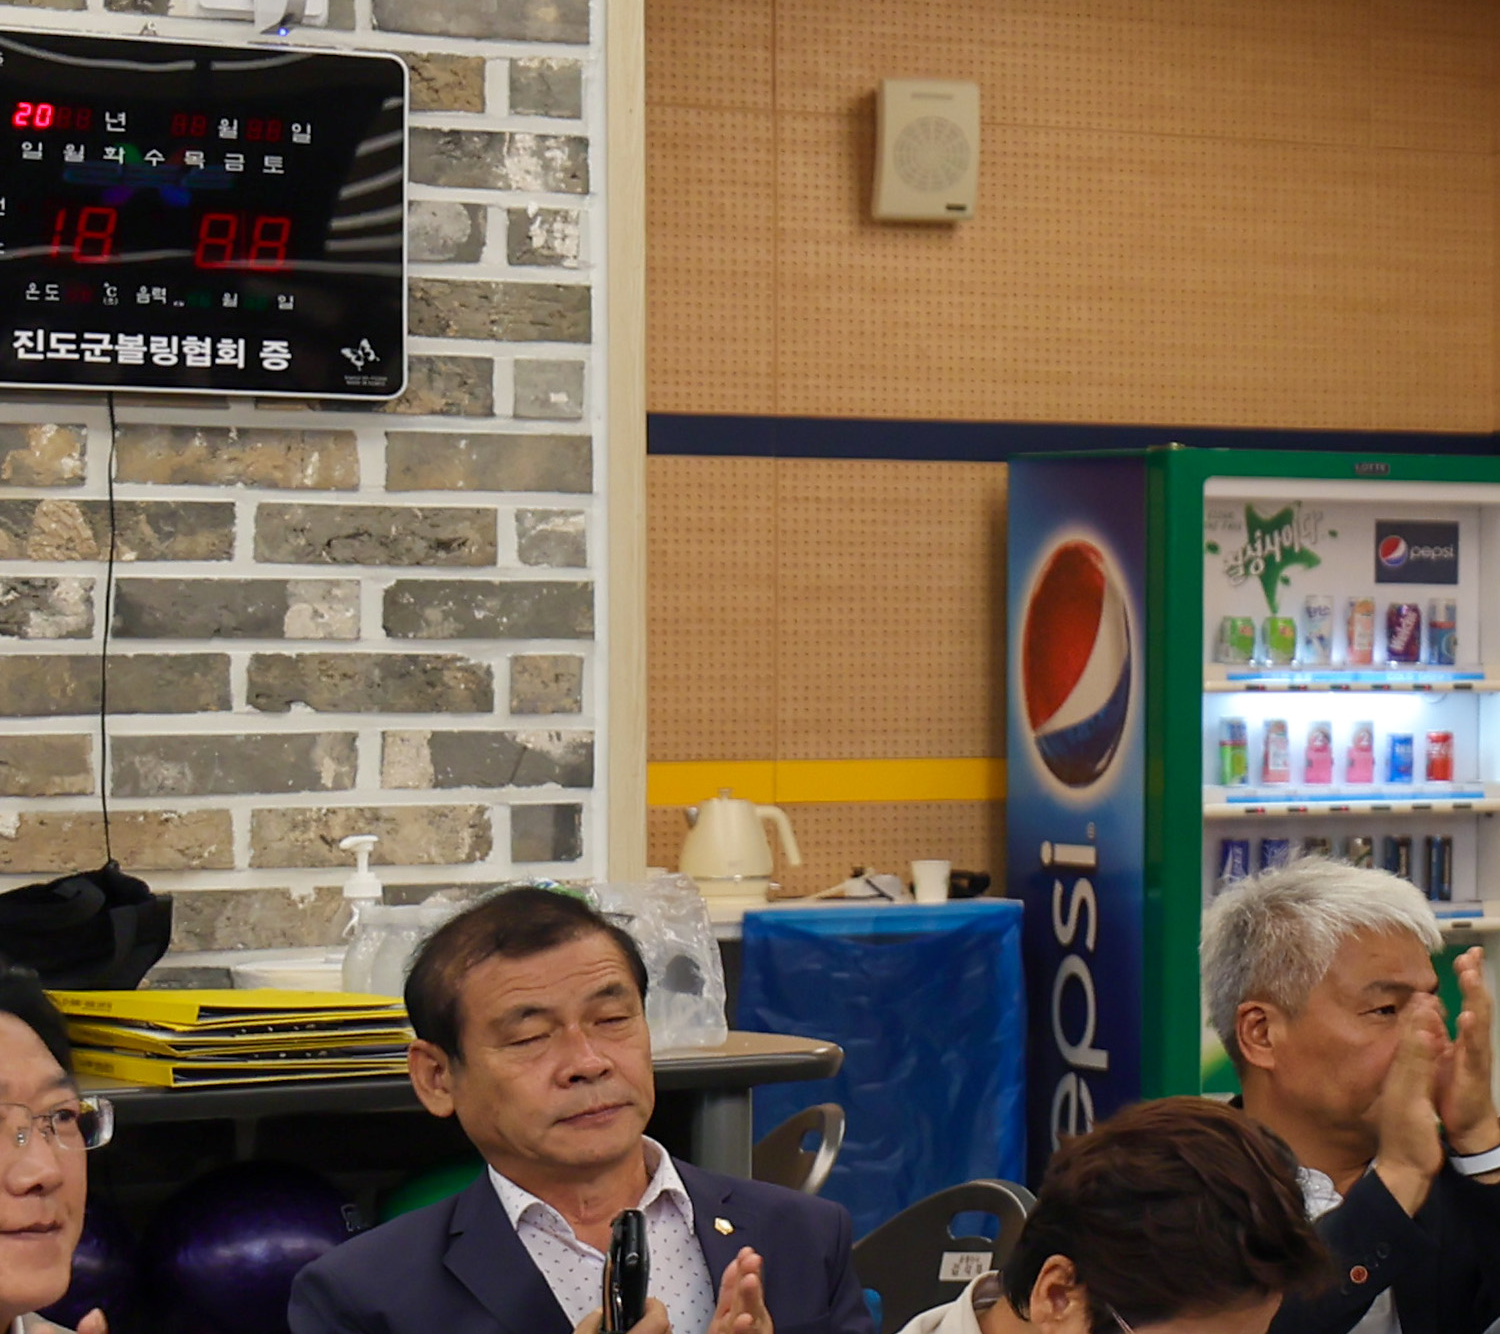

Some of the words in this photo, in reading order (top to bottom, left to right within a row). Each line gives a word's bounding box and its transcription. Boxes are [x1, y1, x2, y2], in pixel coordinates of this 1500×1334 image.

[105, 112, 126, 132] 년
[217, 118, 238, 140] 월
[291, 123, 312, 144] 일
[22, 141, 43, 161] 일
[63, 144, 84, 163] 월
[103, 146, 125, 165] 화
[144, 149, 165, 167] 수
[224, 153, 245, 172] 금
[263, 155, 285, 174] 토
[12, 328, 246, 369] 진도군볼링협회
[259, 339, 293, 371] 증
[1409, 544, 1455, 560] pepsi
[1040, 838, 1109, 1153] epsi
